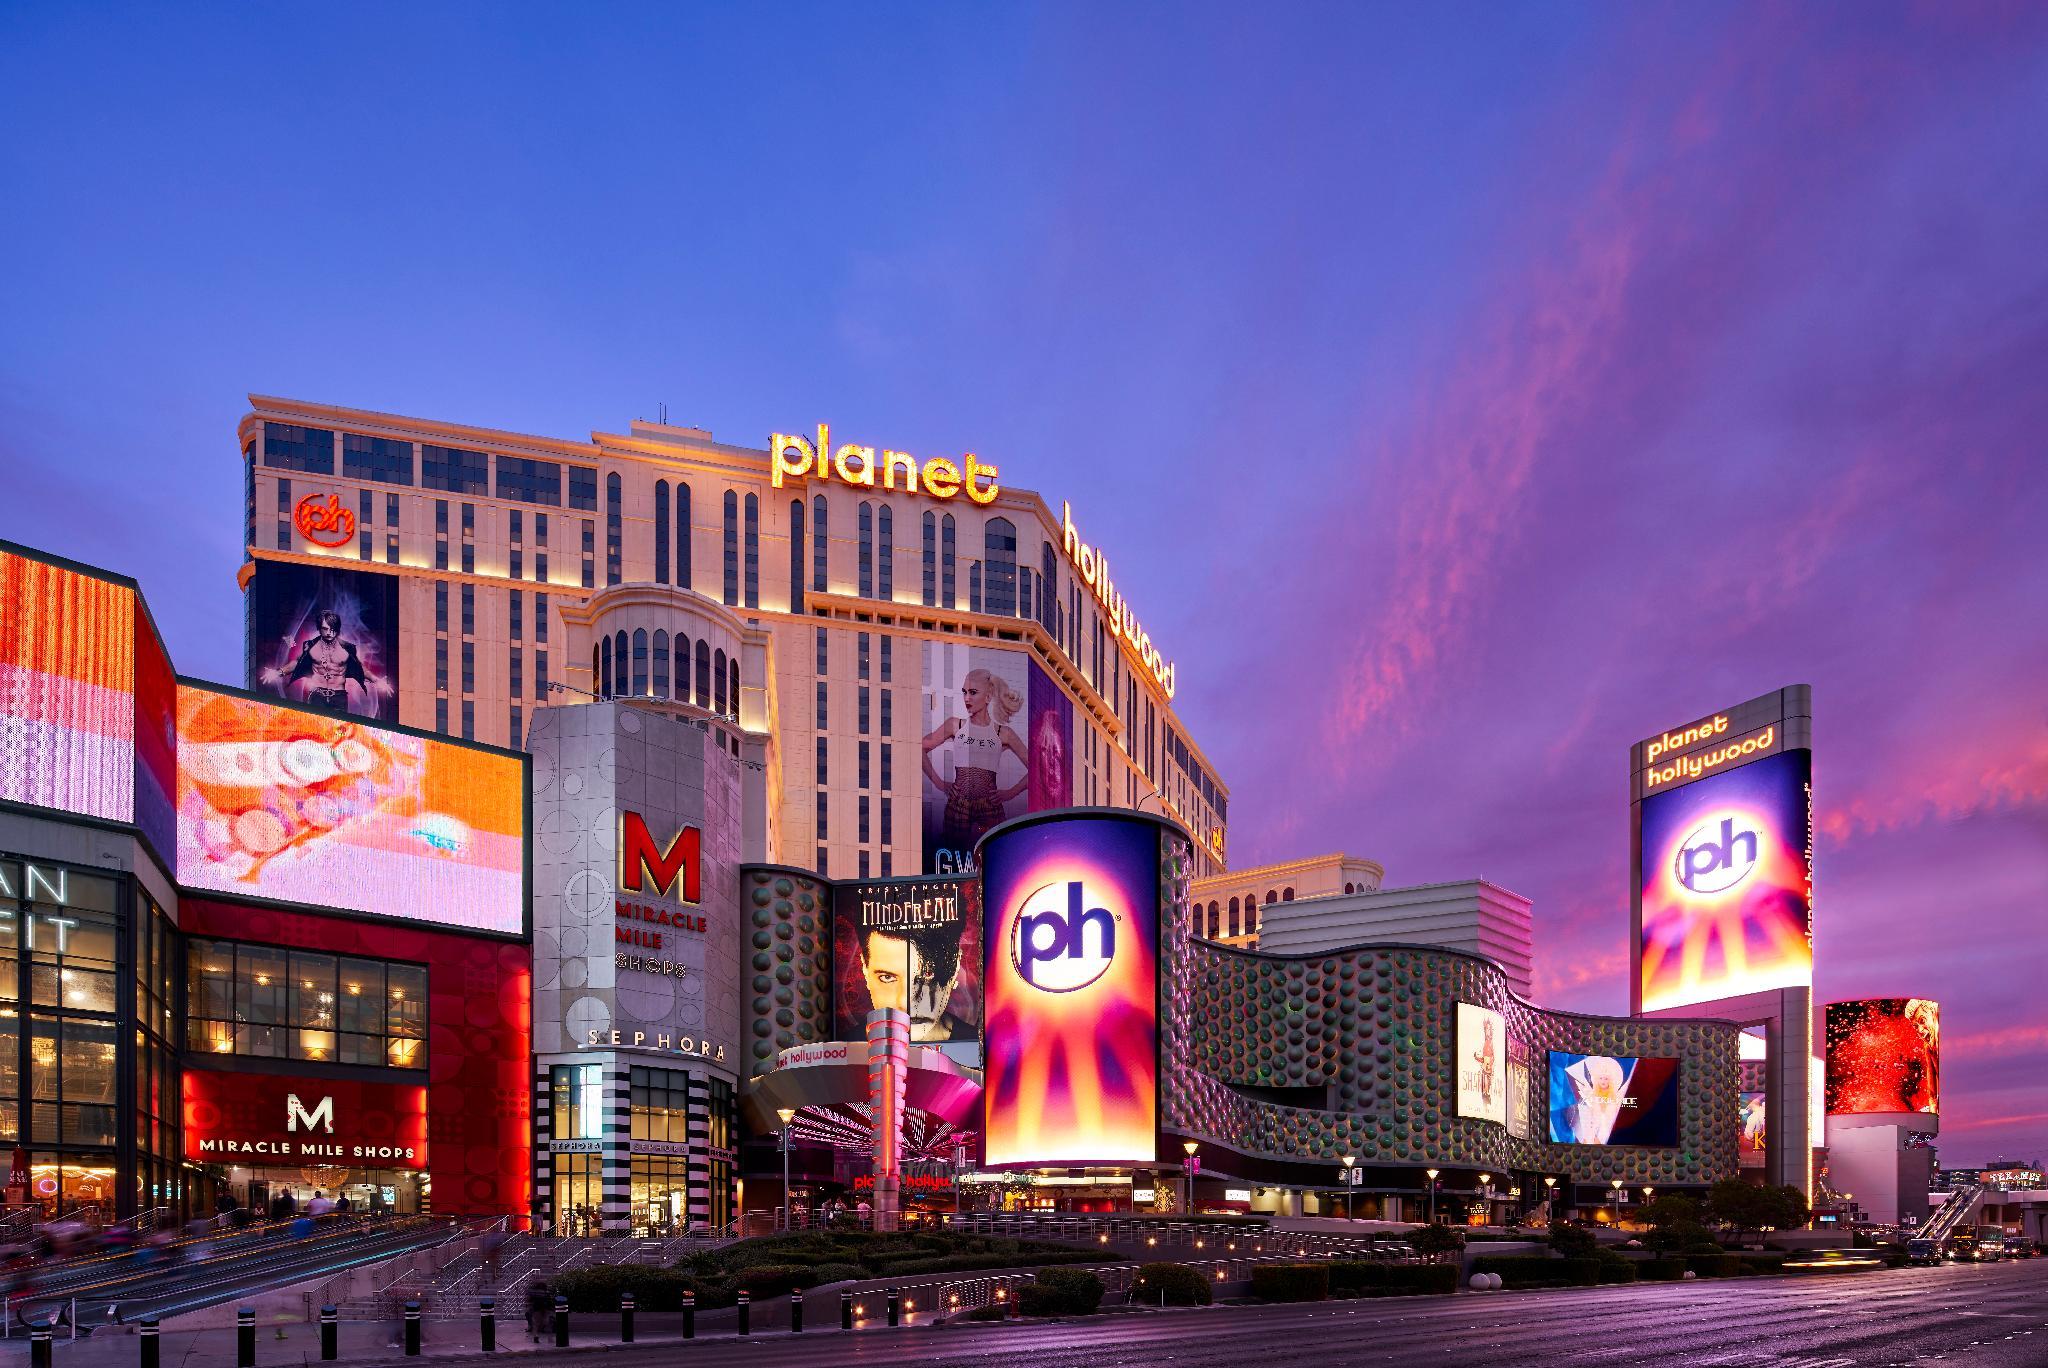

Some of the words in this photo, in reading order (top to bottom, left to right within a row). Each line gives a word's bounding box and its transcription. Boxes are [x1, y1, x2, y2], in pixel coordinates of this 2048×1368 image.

[771, 423, 999, 505] planet
[301, 494, 355, 537] ph
[1063, 500, 1175, 699] hollywood
[1647, 715, 1729, 763] planet
[1647, 727, 1774, 788] hollywood
[623, 810, 701, 904] M
[935, 848, 978, 875] GW
[1683, 818, 1758, 891] ph
[615, 900, 707, 933] MIRACLE
[1020, 881, 1116, 986] ph
[615, 926, 662, 950] MILE
[615, 952, 687, 979] SHOPS
[587, 1029, 725, 1061] SEPHORA
[790, 1046, 847, 1064] hollywood
[287, 1093, 334, 1134] M
[199, 1139, 291, 1154] MIRACLE
[301, 1143, 344, 1156] MILE
[353, 1146, 415, 1159] SHOPS
[551, 1142, 600, 1151] SEPHORA
[634, 1144, 686, 1153] SEPHORA
